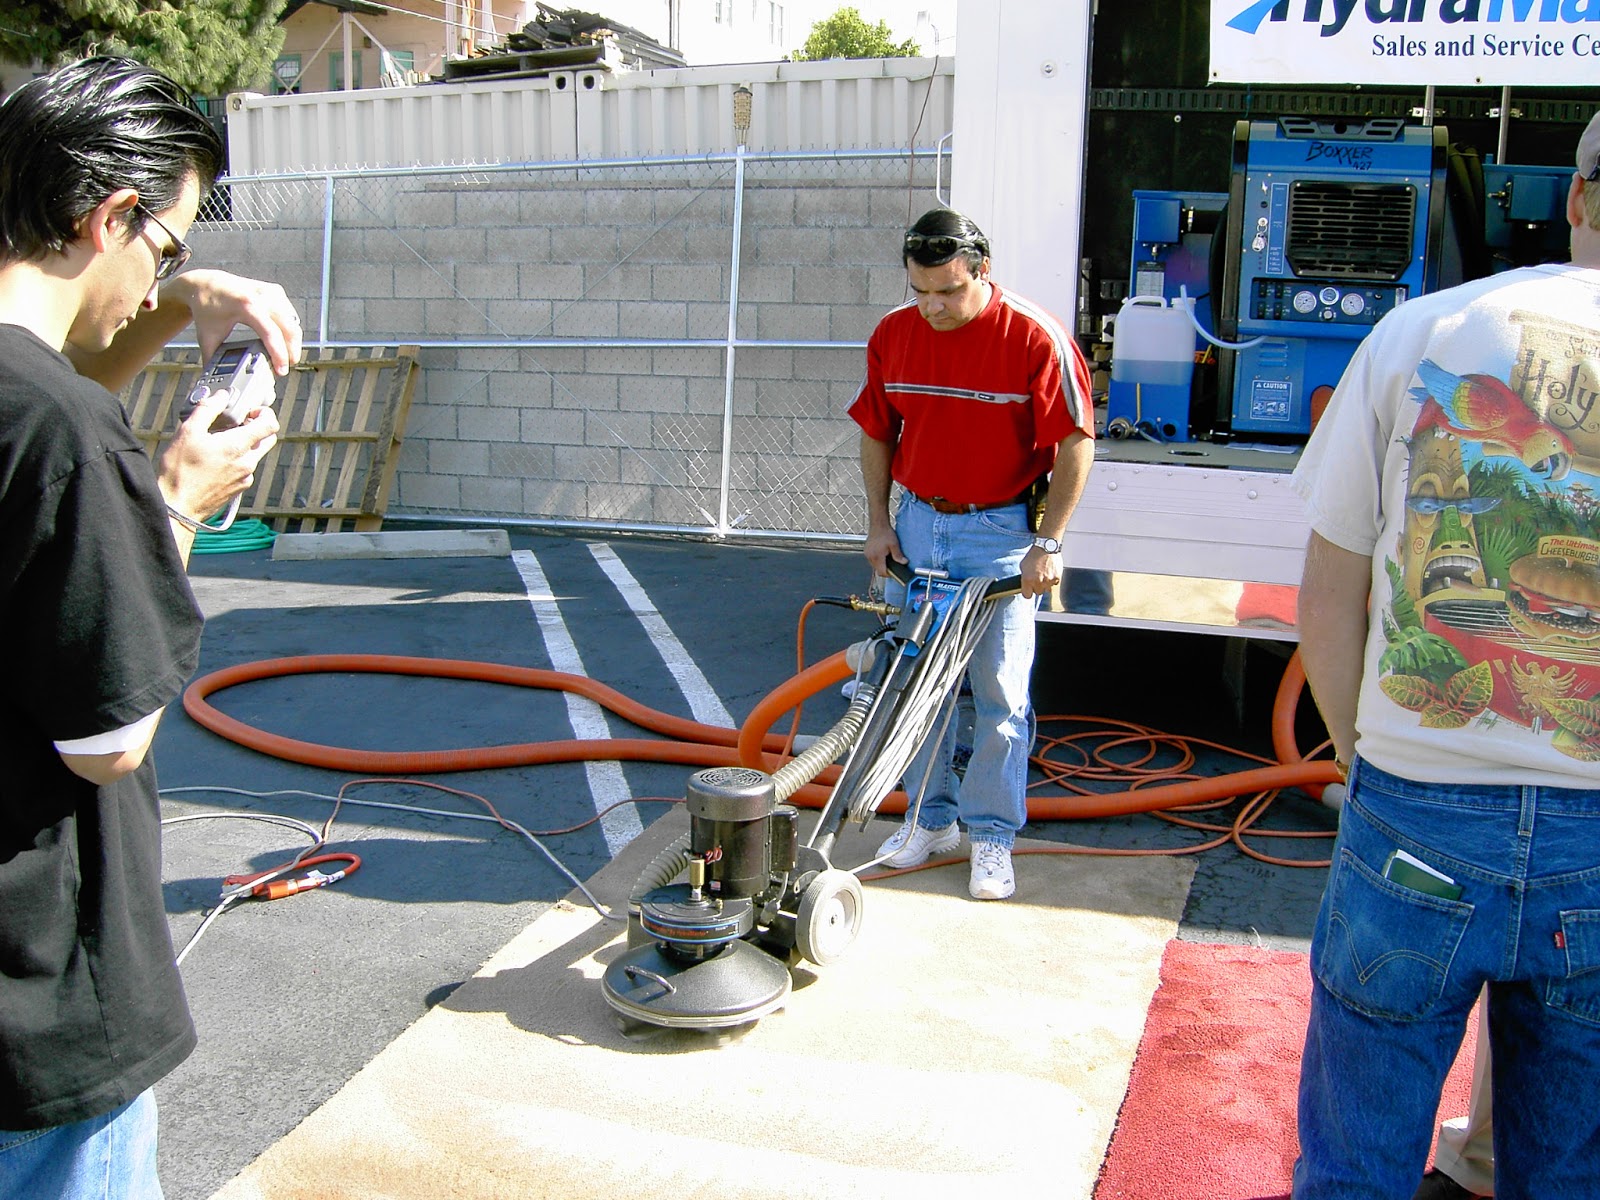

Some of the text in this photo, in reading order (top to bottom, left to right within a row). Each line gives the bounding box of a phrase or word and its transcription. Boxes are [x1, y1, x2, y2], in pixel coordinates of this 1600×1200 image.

[1372, 33, 1600, 57] Sales and Service Ce
[1305, 141, 1374, 164] BOXXER
[1263, 382, 1288, 390] CAUTION
[1516, 349, 1600, 435] Holy
[1541, 542, 1600, 562] CHEESEBURGER
[1550, 538, 1565, 546] The
